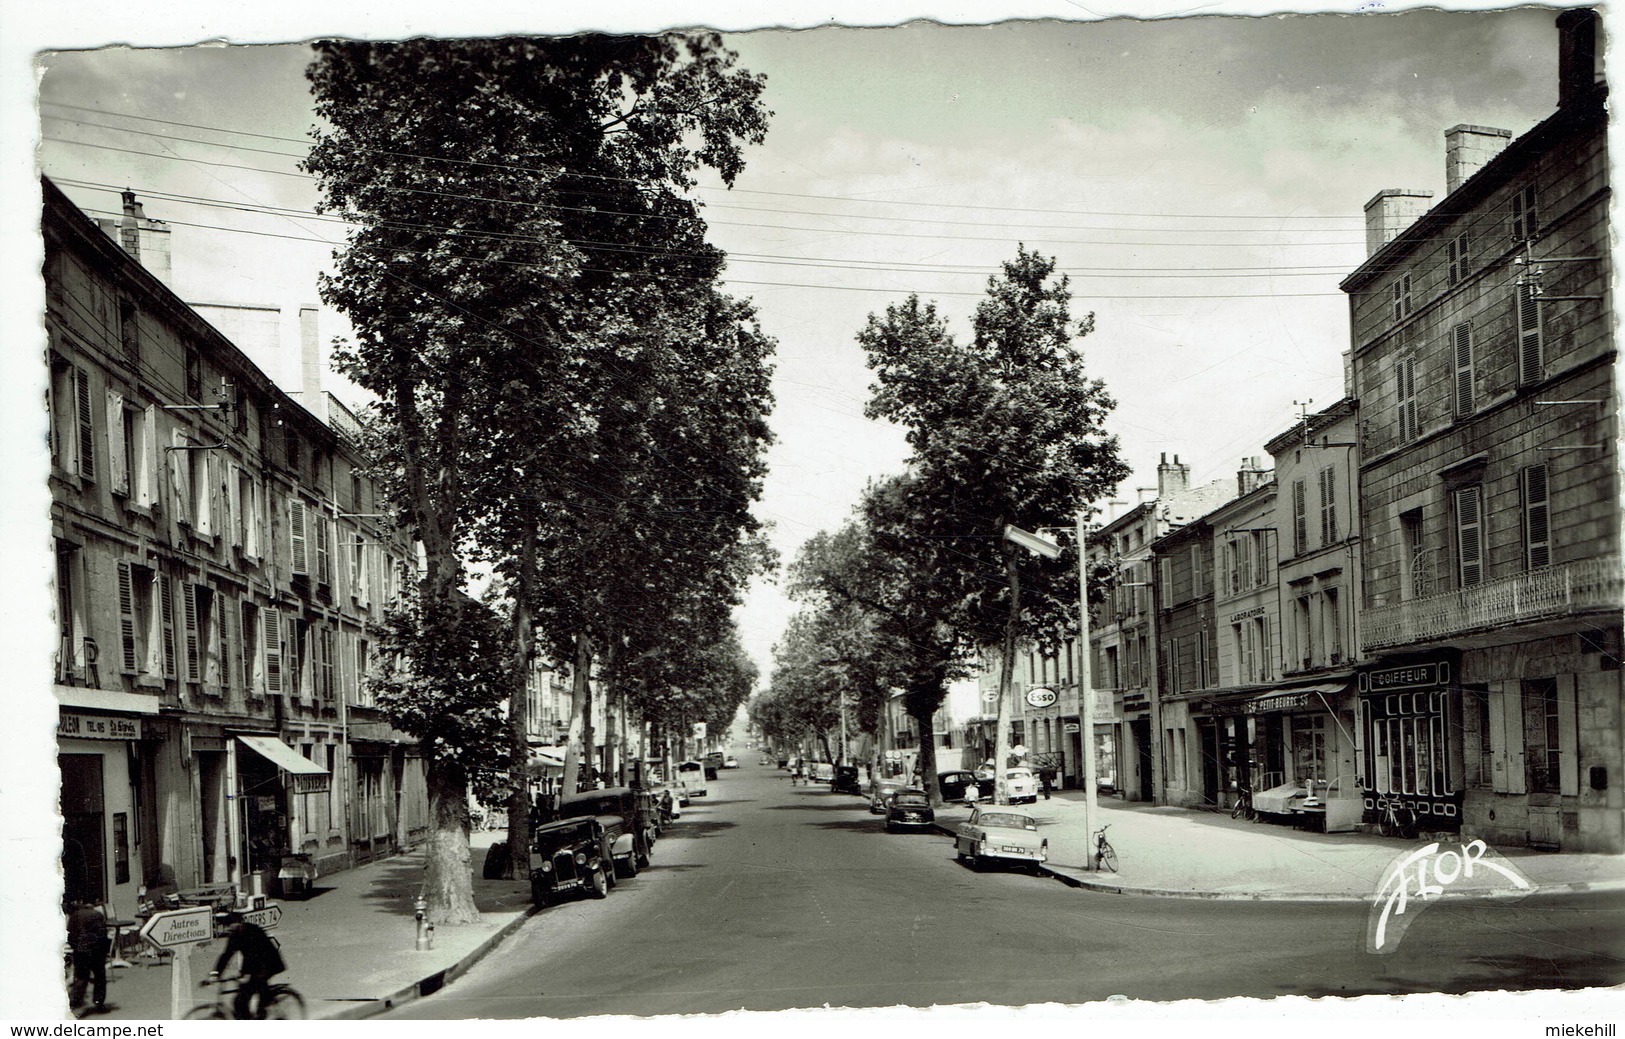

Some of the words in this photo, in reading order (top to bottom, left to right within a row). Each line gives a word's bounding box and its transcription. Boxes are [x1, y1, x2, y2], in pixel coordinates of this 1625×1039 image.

[1230, 606, 1265, 623] LABORATOIRE
[1379, 668, 1428, 685] COIFFEUR
[169, 918, 200, 931] Autres
[163, 928, 206, 942] Directions
